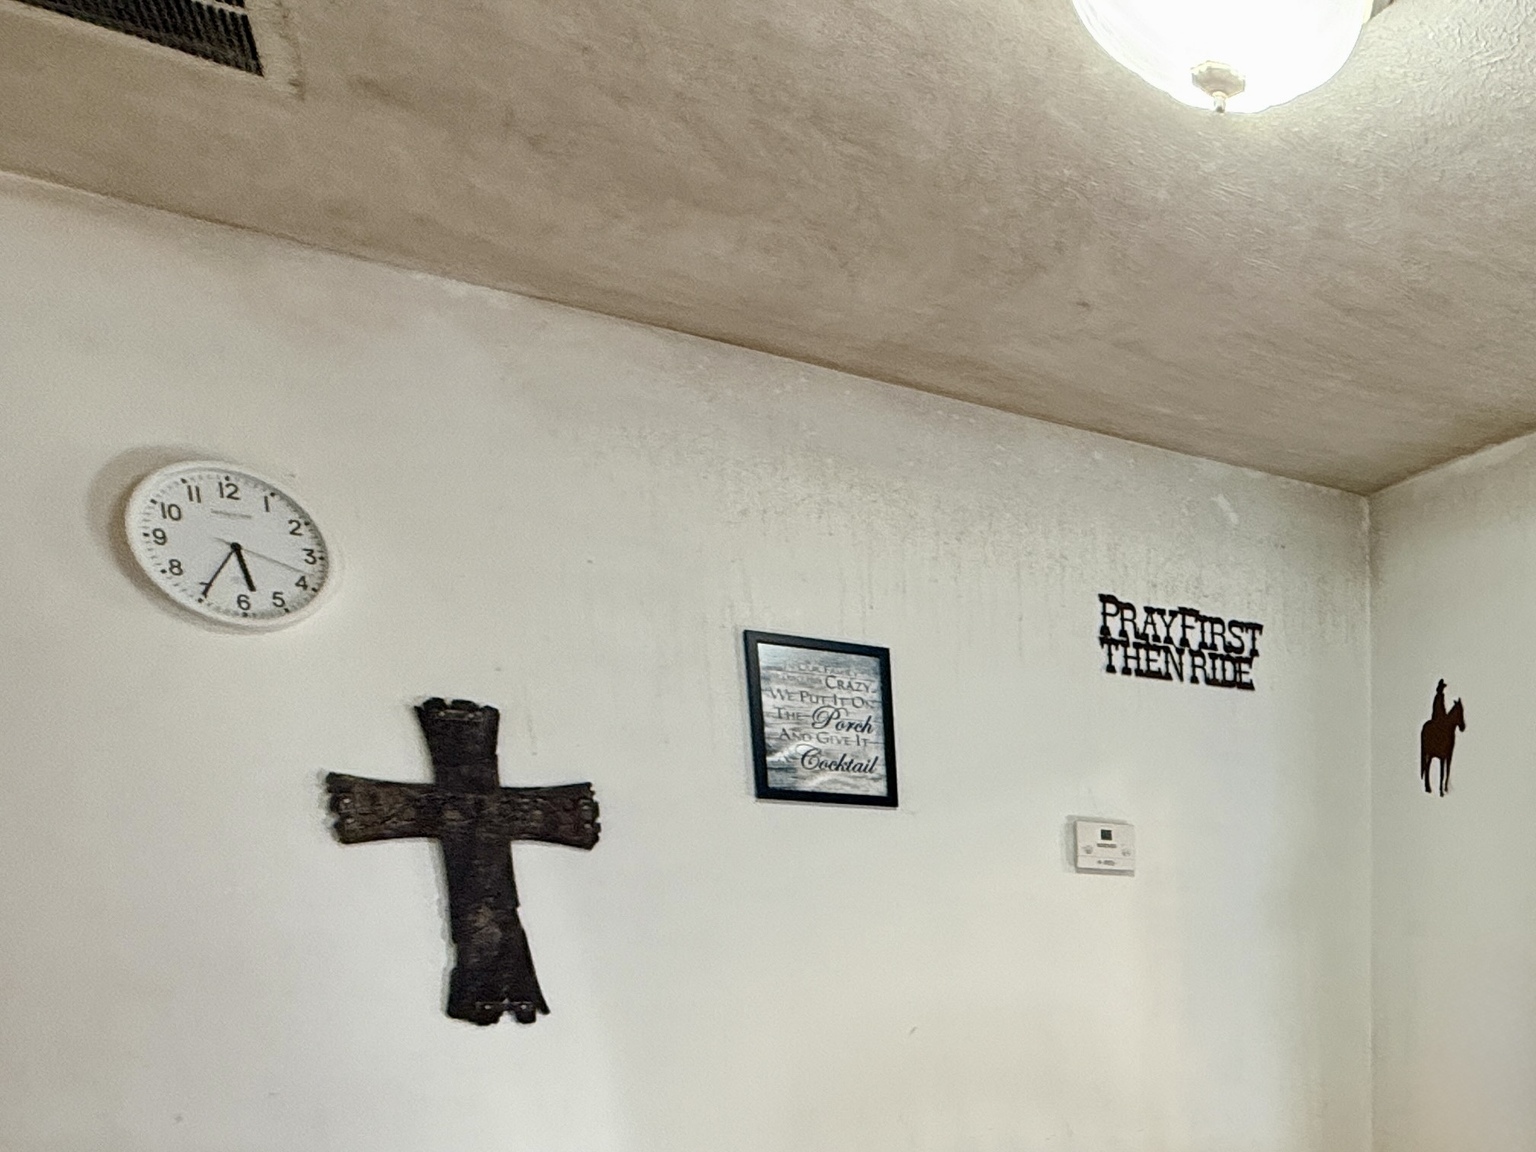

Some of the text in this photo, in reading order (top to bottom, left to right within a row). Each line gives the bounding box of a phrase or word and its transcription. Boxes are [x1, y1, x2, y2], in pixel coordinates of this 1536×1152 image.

[186, 485, 202, 504] 11
[218, 481, 241, 501] 12
[160, 502, 182, 522] 10
[264, 495, 270, 513] 1
[152, 528, 167, 546] 9
[288, 519, 303, 537] 2
[302, 548, 317, 565] 3
[168, 559, 184, 576] 8
[294, 575, 309, 591] 4
[236, 594, 251, 611] 6
[272, 591, 286, 608] 5
[1098, 593, 1264, 657] PRAY FIRST
[1098, 636, 1255, 691] THEN RIDE
[774, 705, 874, 734] THE Porch
[779, 727, 812, 742] AND
[816, 731, 850, 746] GIVE
[795, 743, 879, 774] Cocktail
